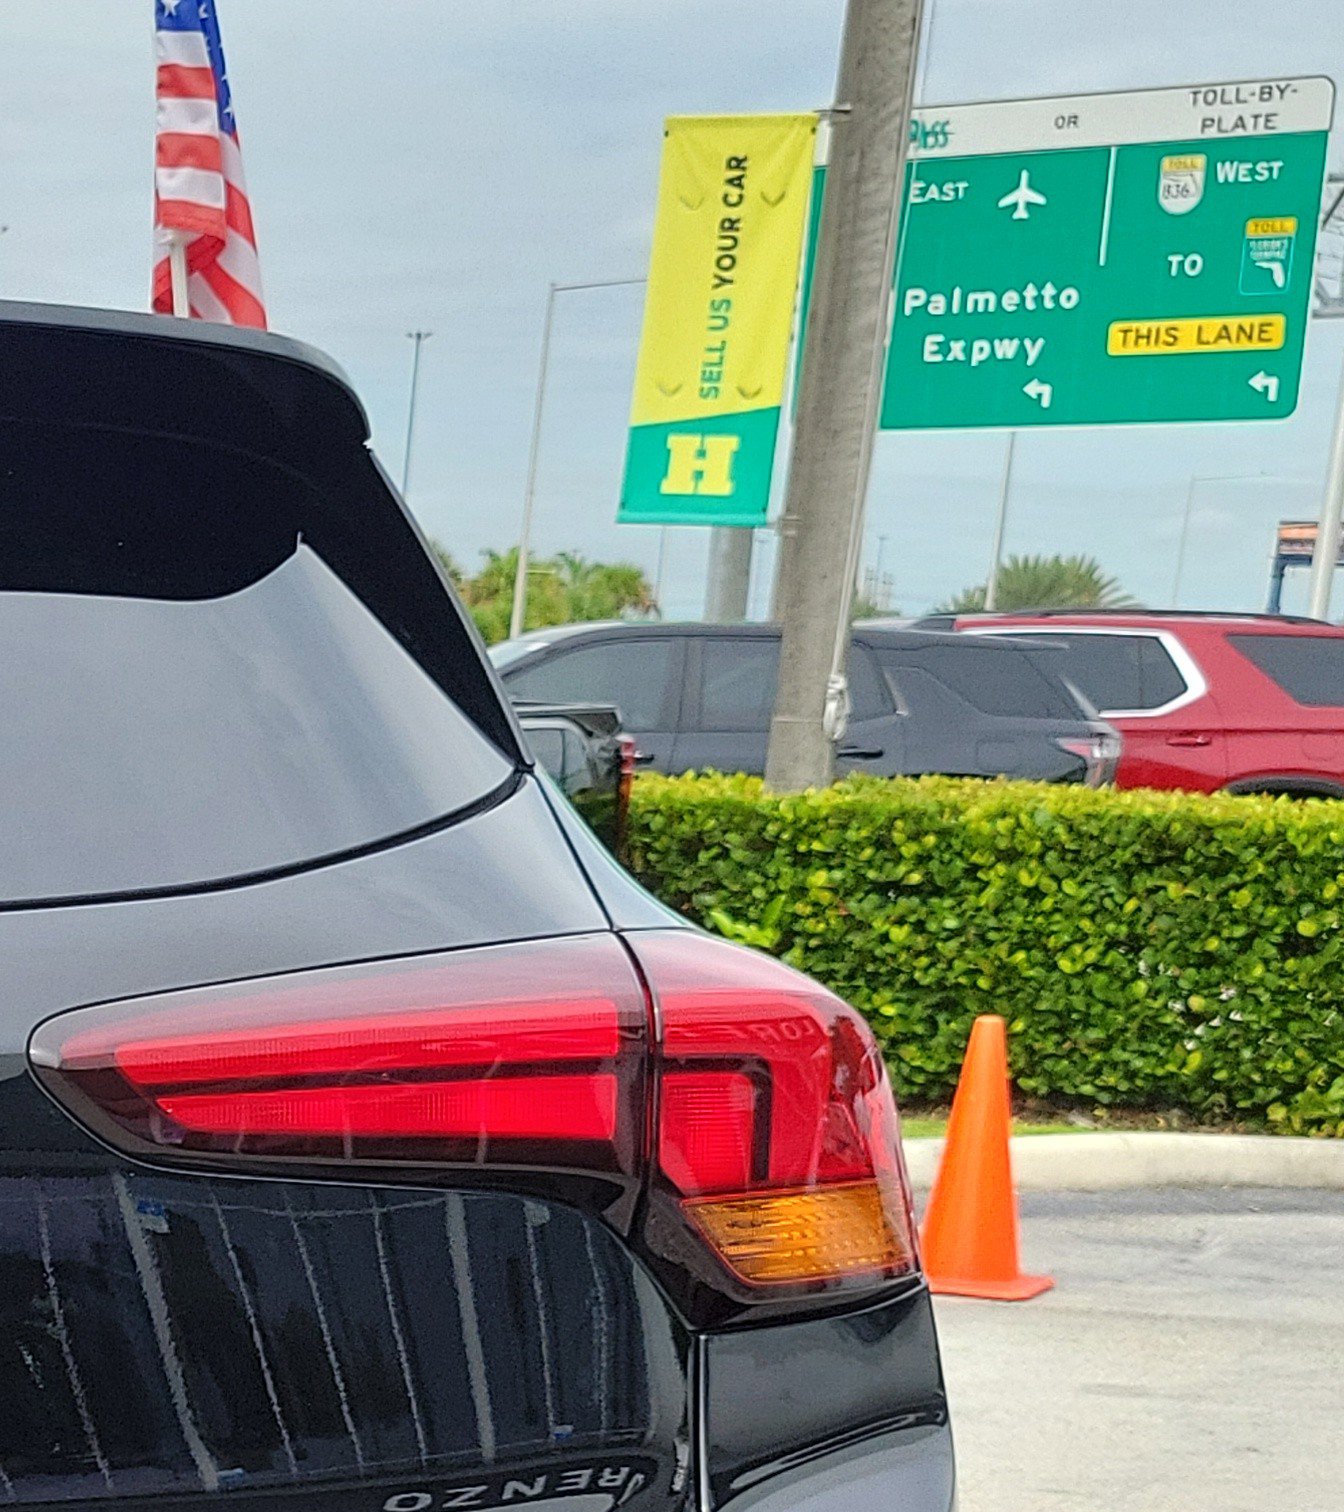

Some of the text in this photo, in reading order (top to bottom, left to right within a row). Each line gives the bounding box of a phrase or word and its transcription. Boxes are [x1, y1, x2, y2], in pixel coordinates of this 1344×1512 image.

[1054, 114, 1080, 130] OR
[1200, 112, 1279, 135] PLATE
[1216, 160, 1284, 184] WEST
[909, 180, 970, 204] EAST
[699, 155, 748, 400] SELL US YOUR CAR
[1167, 253, 1204, 277] TO
[903, 282, 1081, 317] Palmetto
[1118, 321, 1275, 348] THIS LANE
[922, 333, 1045, 367] Expwy
[660, 433, 740, 496] H
